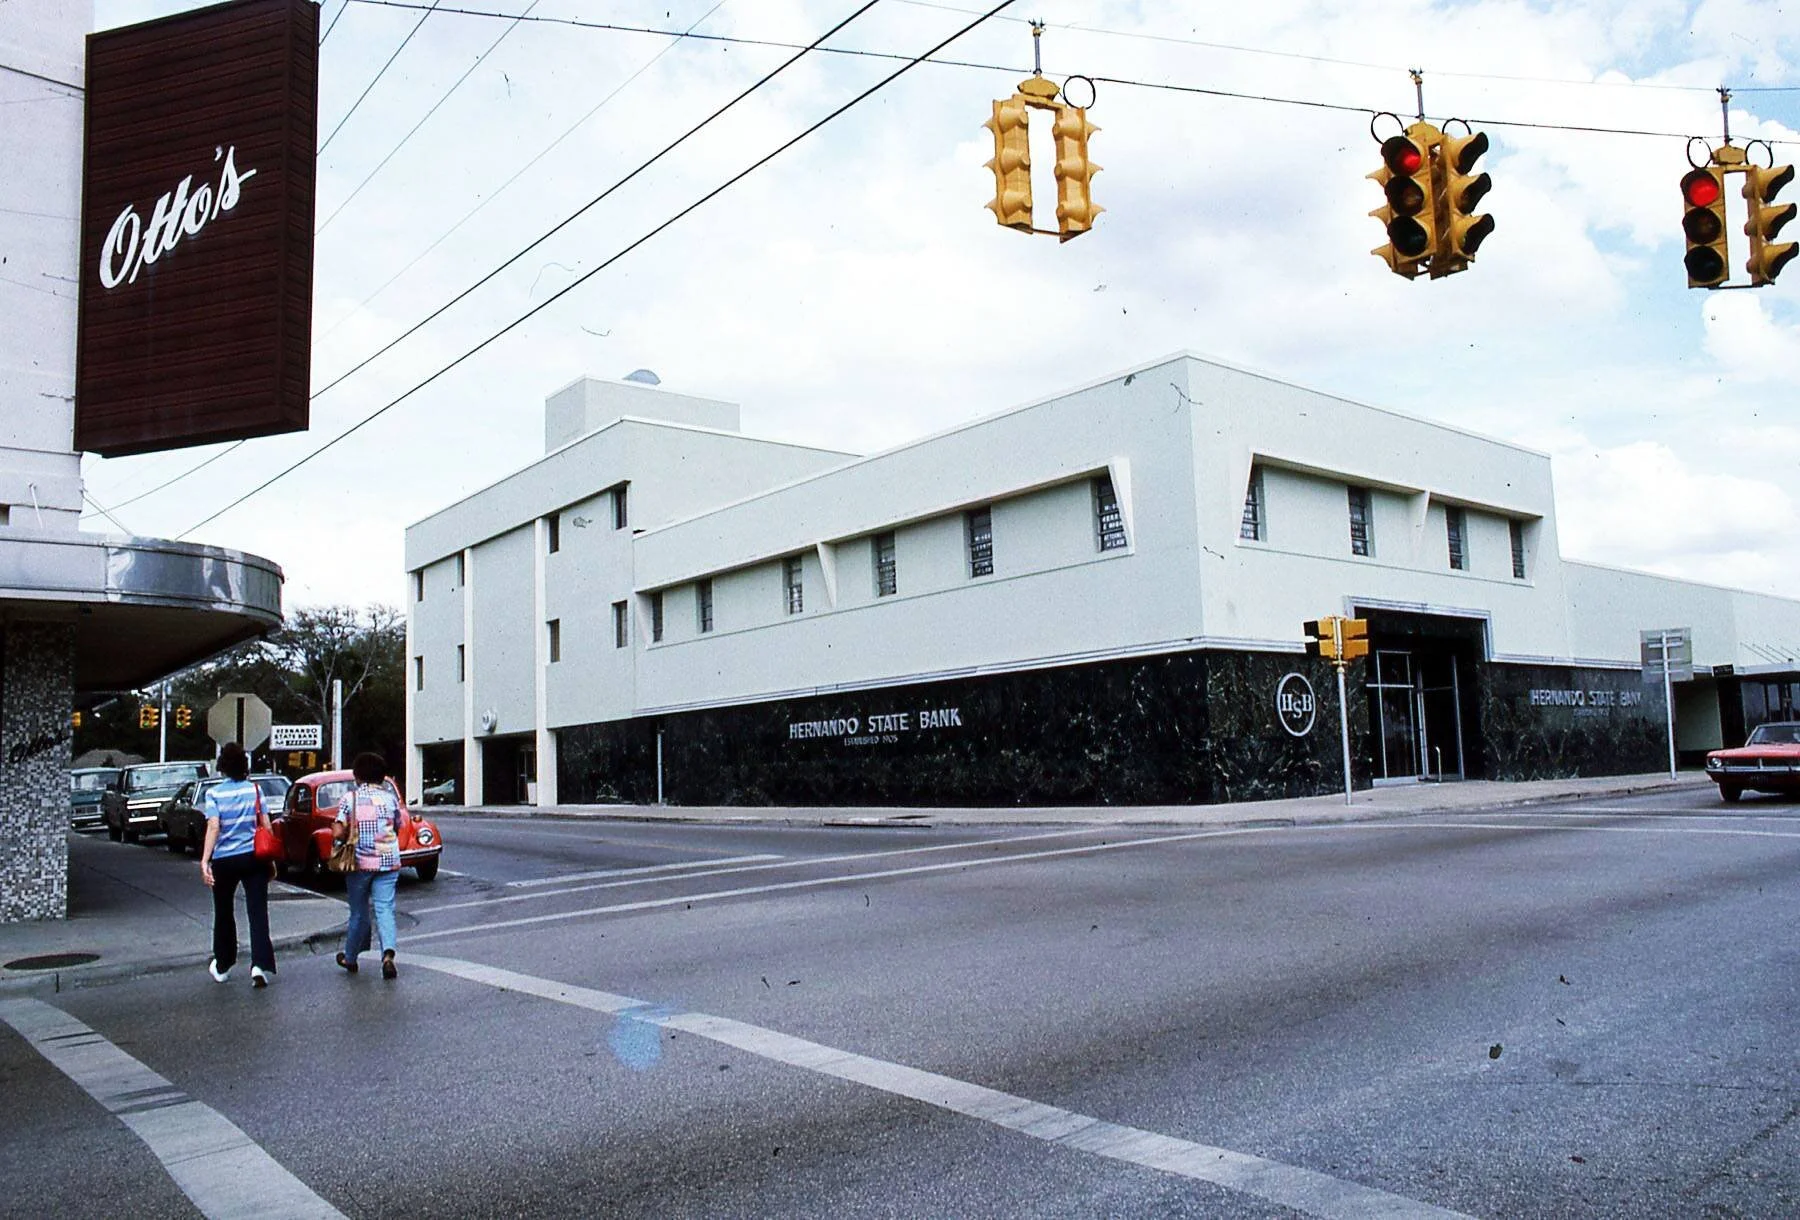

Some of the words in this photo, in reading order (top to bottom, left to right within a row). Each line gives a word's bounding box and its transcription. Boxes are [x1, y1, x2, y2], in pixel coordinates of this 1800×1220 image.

[99, 145, 257, 289] Otto's
[1531, 689, 1585, 706] HERNANDO
[1588, 690, 1616, 707] STATE
[789, 717, 860, 739] HERNANDO
[868, 713, 910, 733] STATE
[919, 708, 962, 729] BANK
